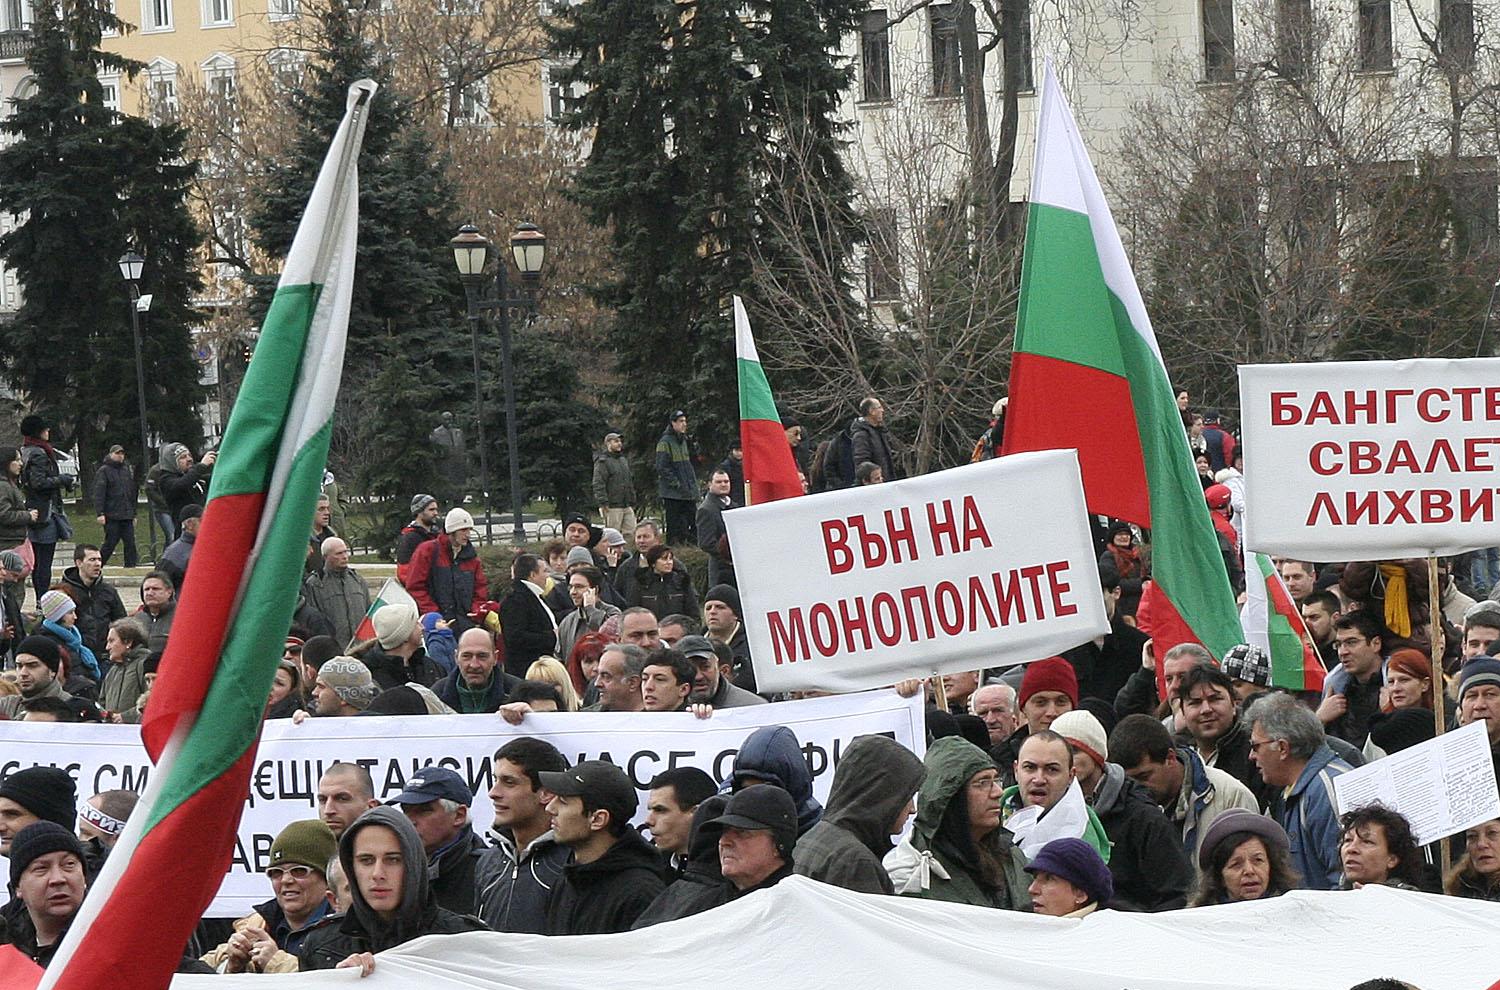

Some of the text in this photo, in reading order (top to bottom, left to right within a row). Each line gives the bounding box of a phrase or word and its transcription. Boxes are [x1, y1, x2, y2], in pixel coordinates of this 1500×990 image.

[820, 495, 992, 575] ВЪН НА
[767, 560, 1078, 665] МОНОПОЛИТЕ
